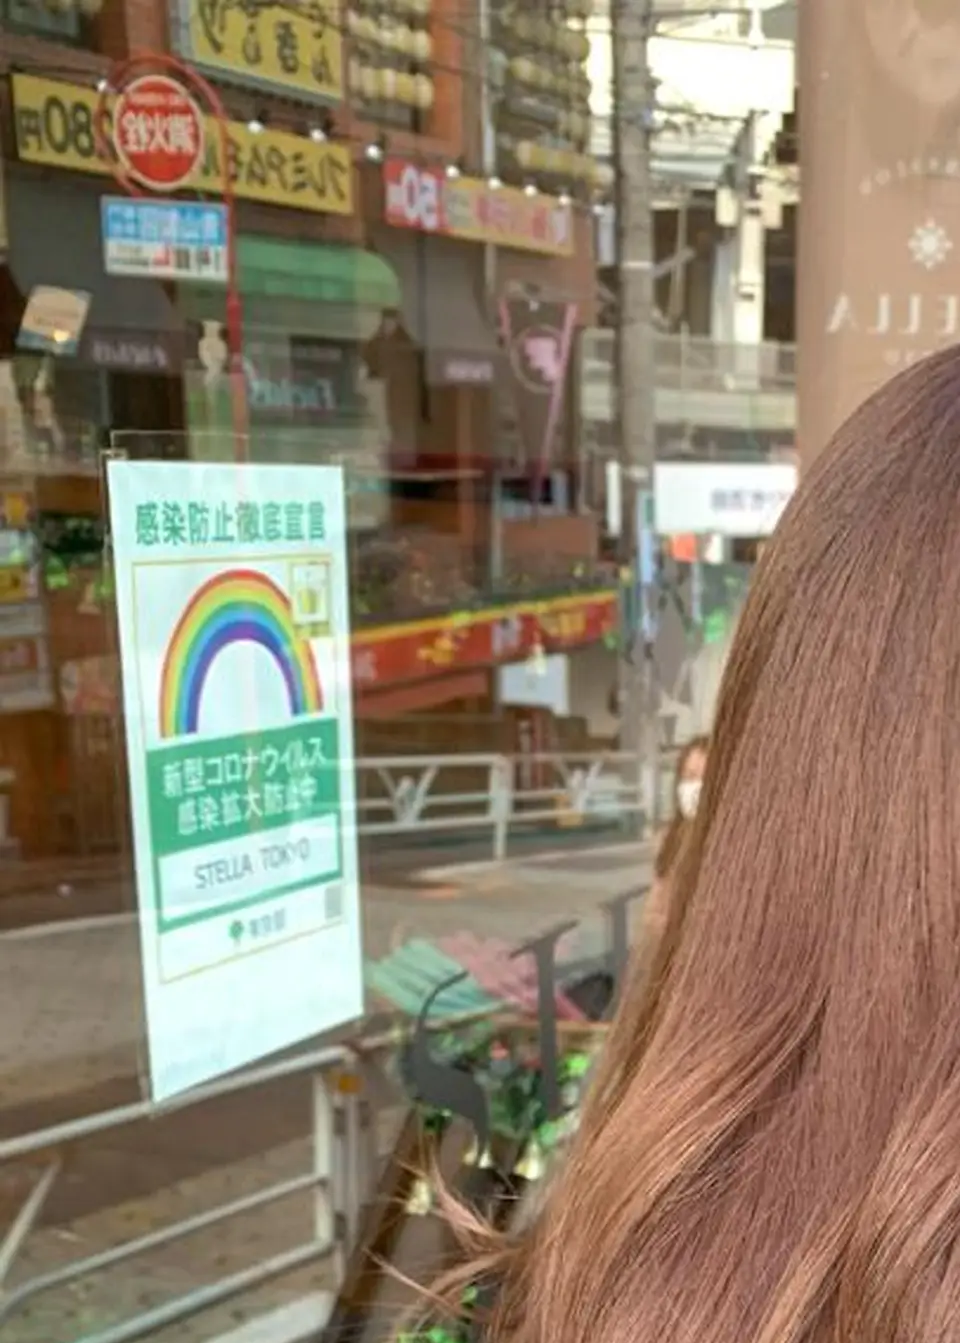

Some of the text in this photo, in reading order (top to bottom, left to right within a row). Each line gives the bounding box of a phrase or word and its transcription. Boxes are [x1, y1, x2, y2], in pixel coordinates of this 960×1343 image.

[135, 501, 326, 546] 感染防止徹底宣言
[163, 736, 327, 797] 新型コロナウイルス
[177, 777, 318, 836] 感染拡大防止中
[195, 838, 310, 891] STELLA TOKYO
